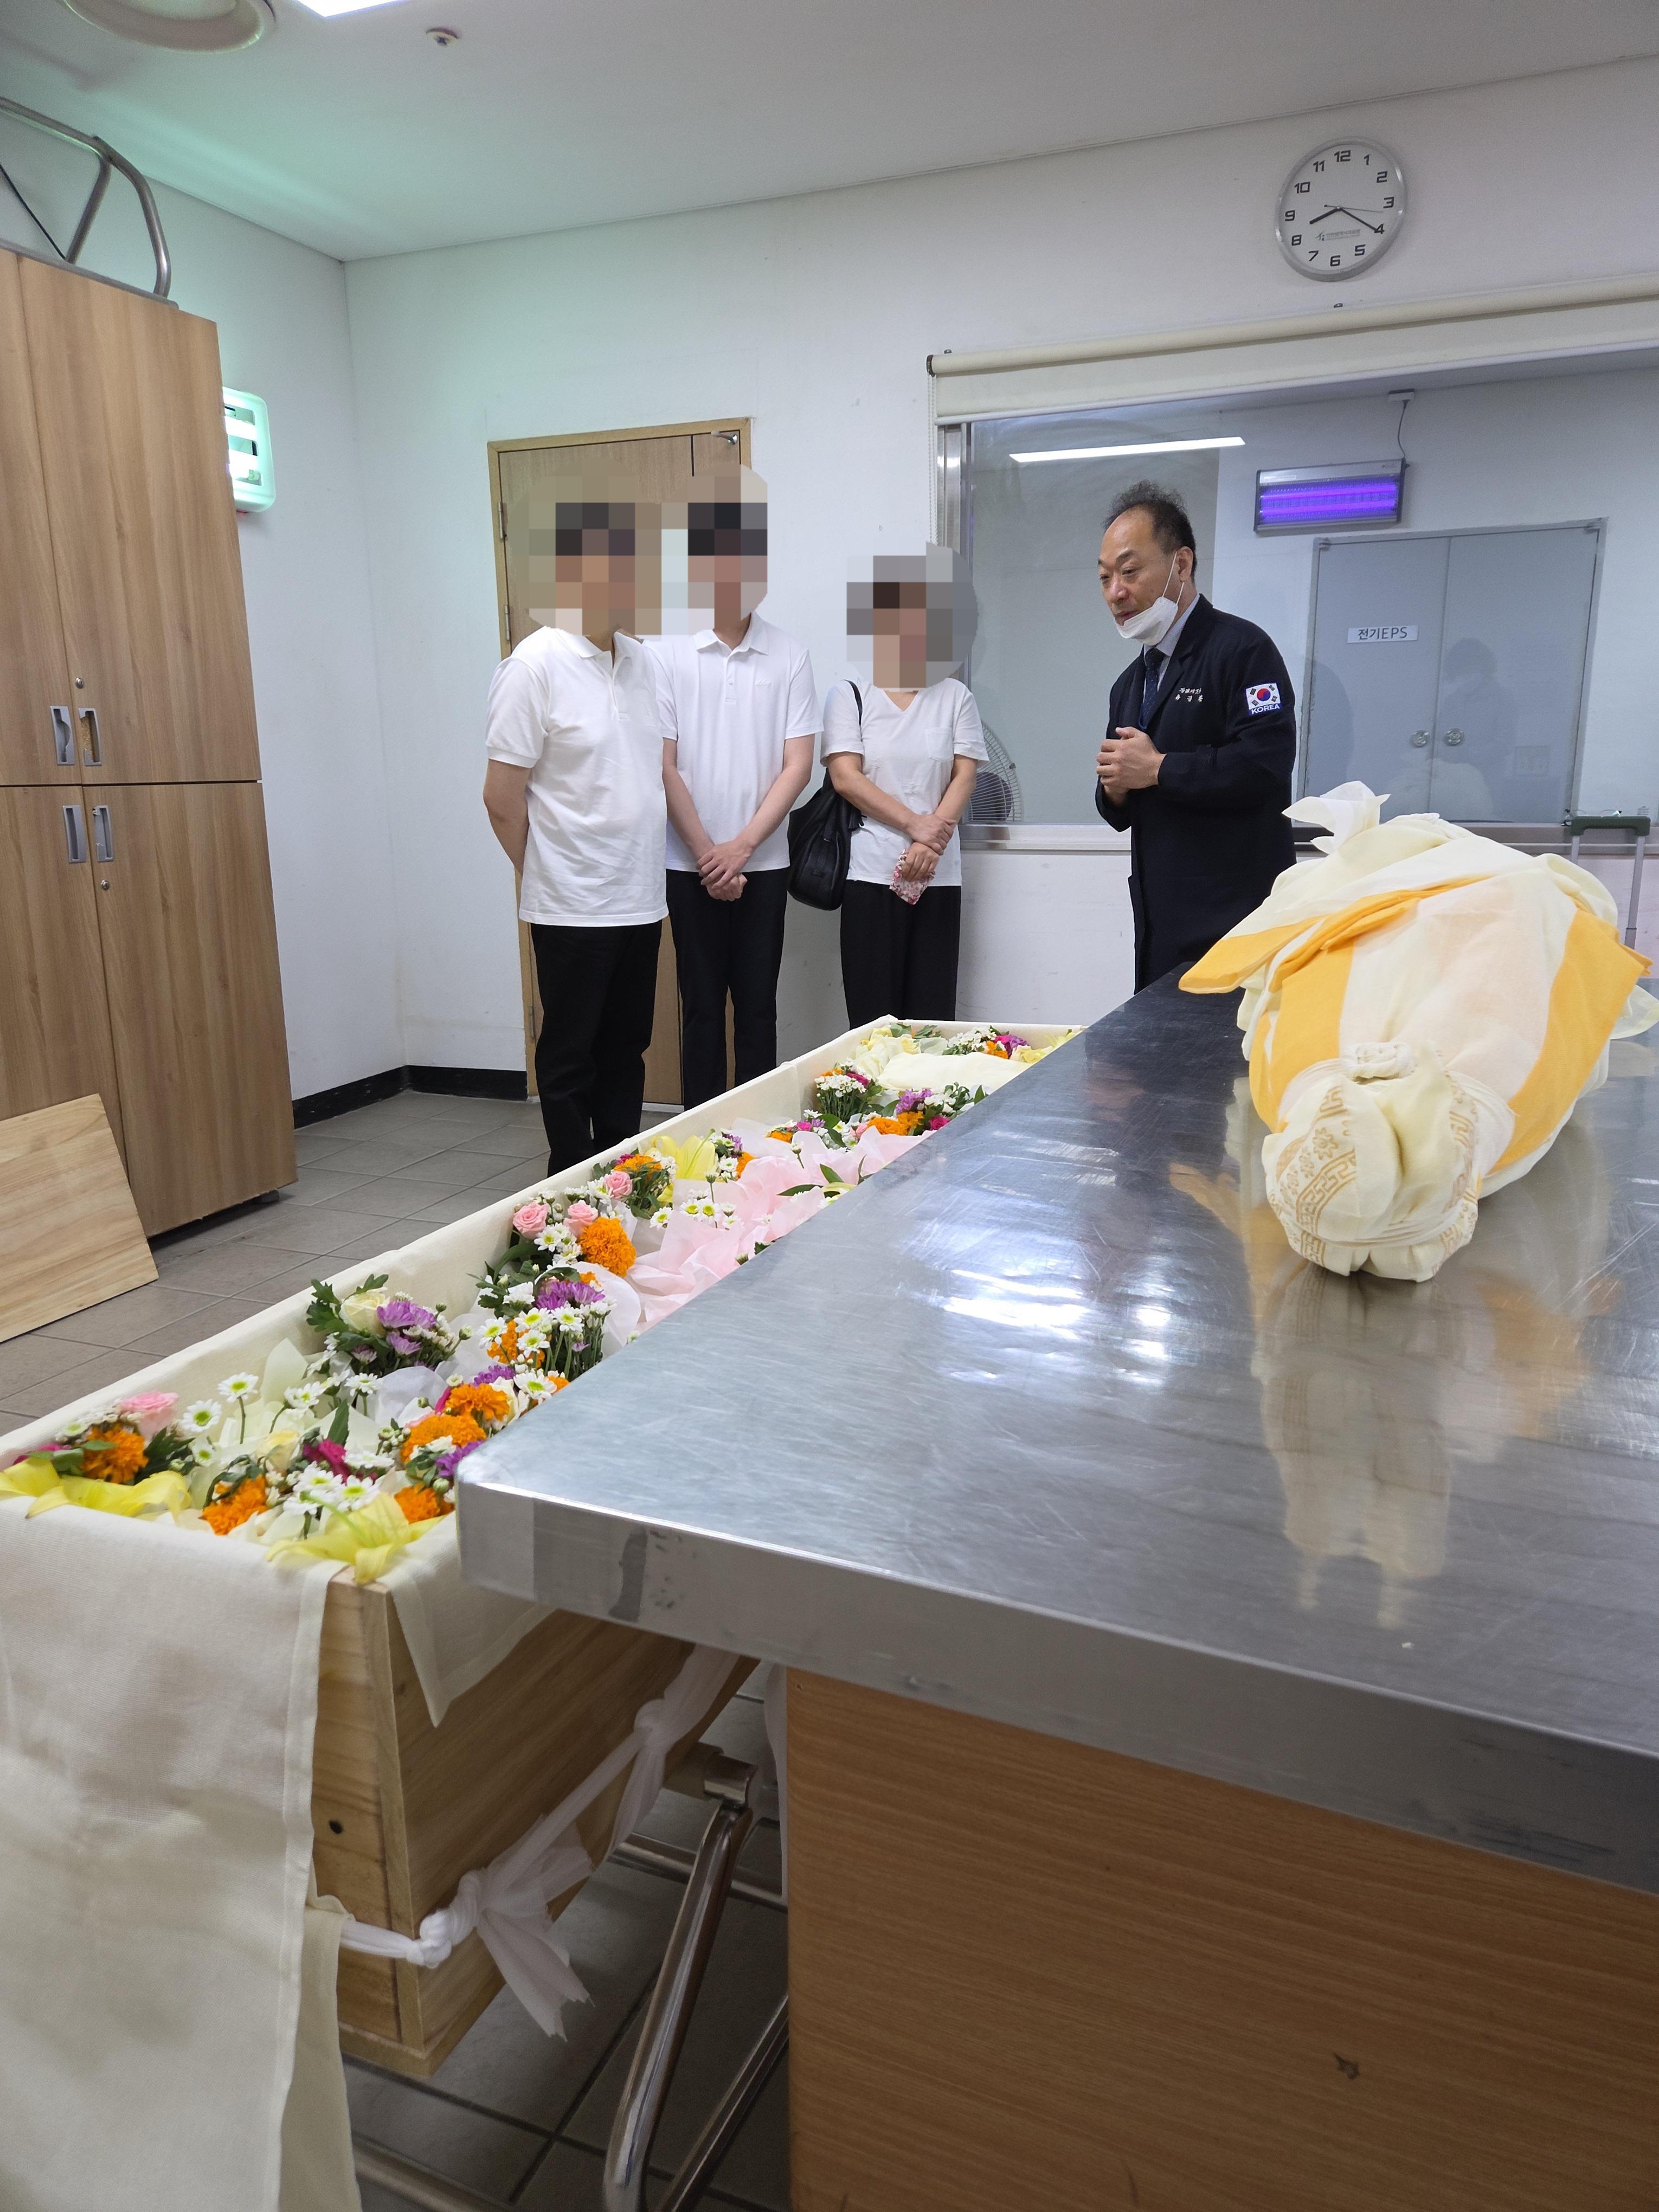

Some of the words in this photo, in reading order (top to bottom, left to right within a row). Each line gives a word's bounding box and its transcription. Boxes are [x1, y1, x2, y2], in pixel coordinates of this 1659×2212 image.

[1334, 150, 1351, 162] 12
[1364, 154, 1370, 165] 1
[1313, 160, 1325, 172] 11
[1376, 171, 1388, 183] 2
[1294, 182, 1310, 194] 10
[1383, 196, 1394, 209] 3
[1285, 210, 1295, 222] 9
[1374, 223, 1385, 234] 4
[1291, 234, 1302, 246] 8
[1308, 250, 1319, 261] 7
[1354, 244, 1366, 256] 5
[1330, 255, 1341, 267] 6
[1358, 626, 1407, 640] 전기EPS
[1251, 703, 1281, 715] KOREA
